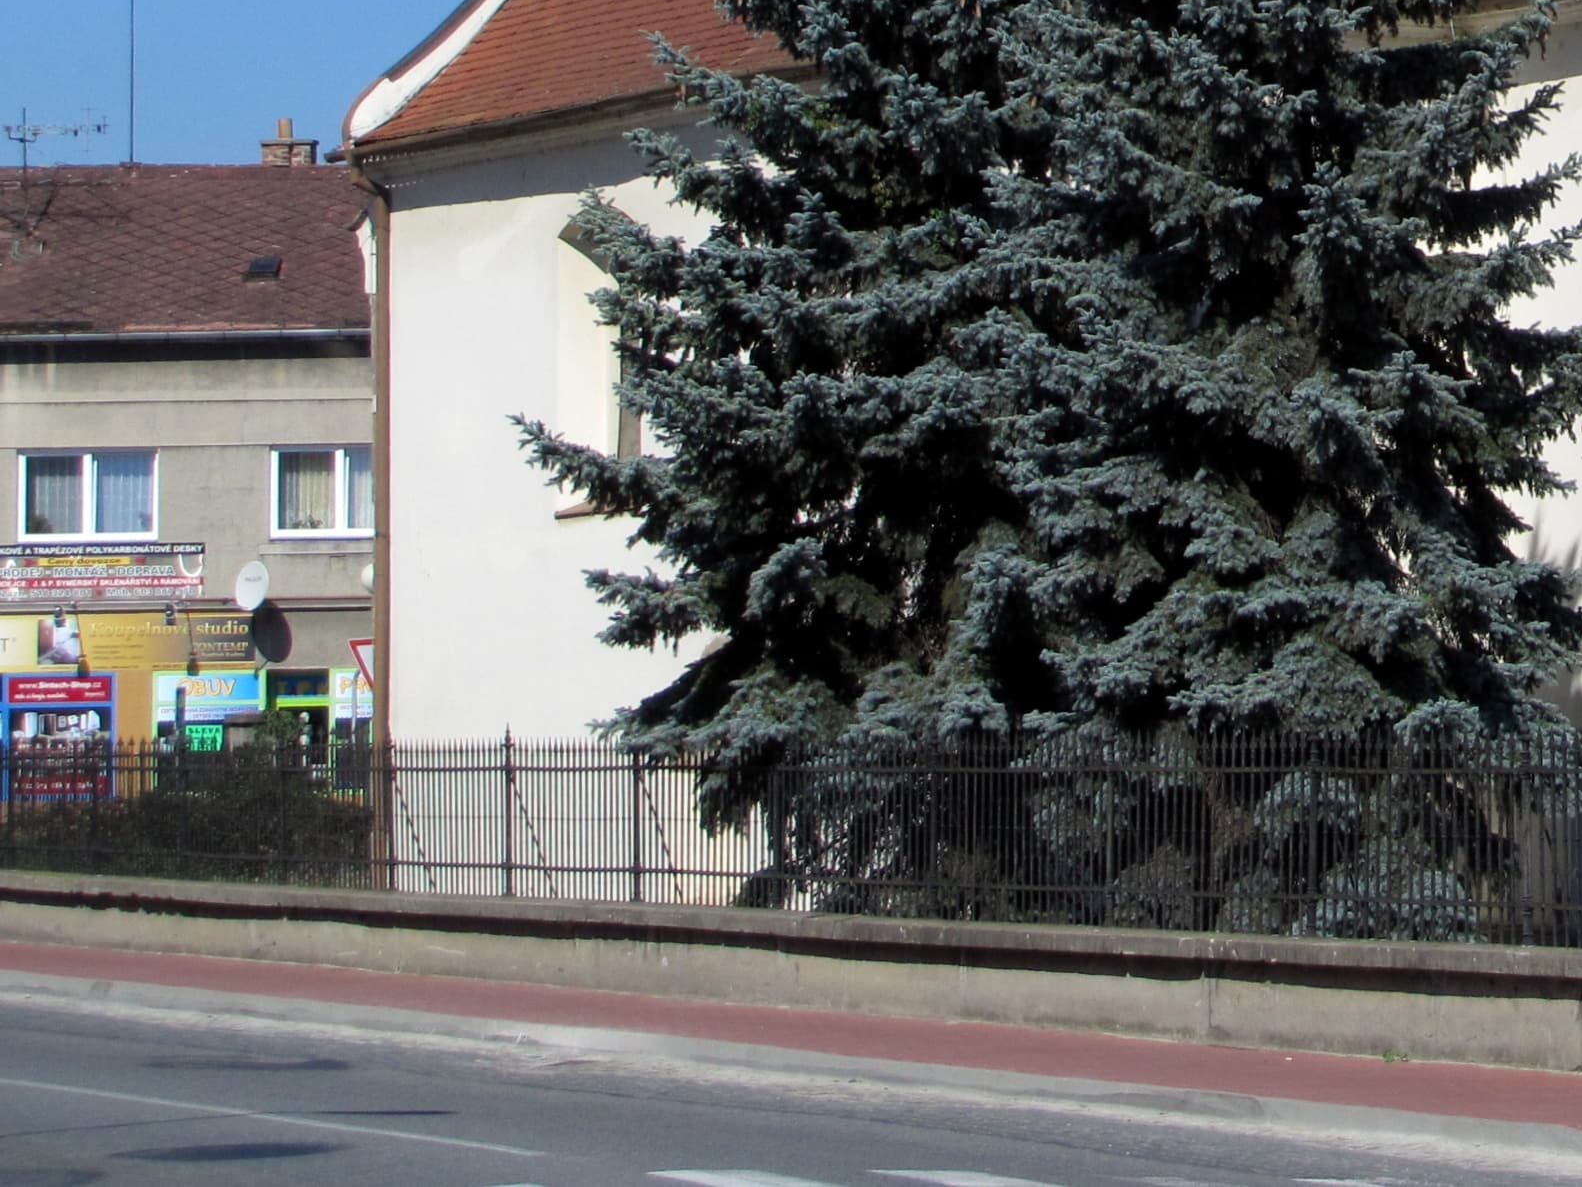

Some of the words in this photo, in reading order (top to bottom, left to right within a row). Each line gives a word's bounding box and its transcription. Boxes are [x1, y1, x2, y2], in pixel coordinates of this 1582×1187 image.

[173, 545, 203, 553] DESKY
[116, 566, 176, 576] DOPRAVA
[196, 620, 248, 635] studio
